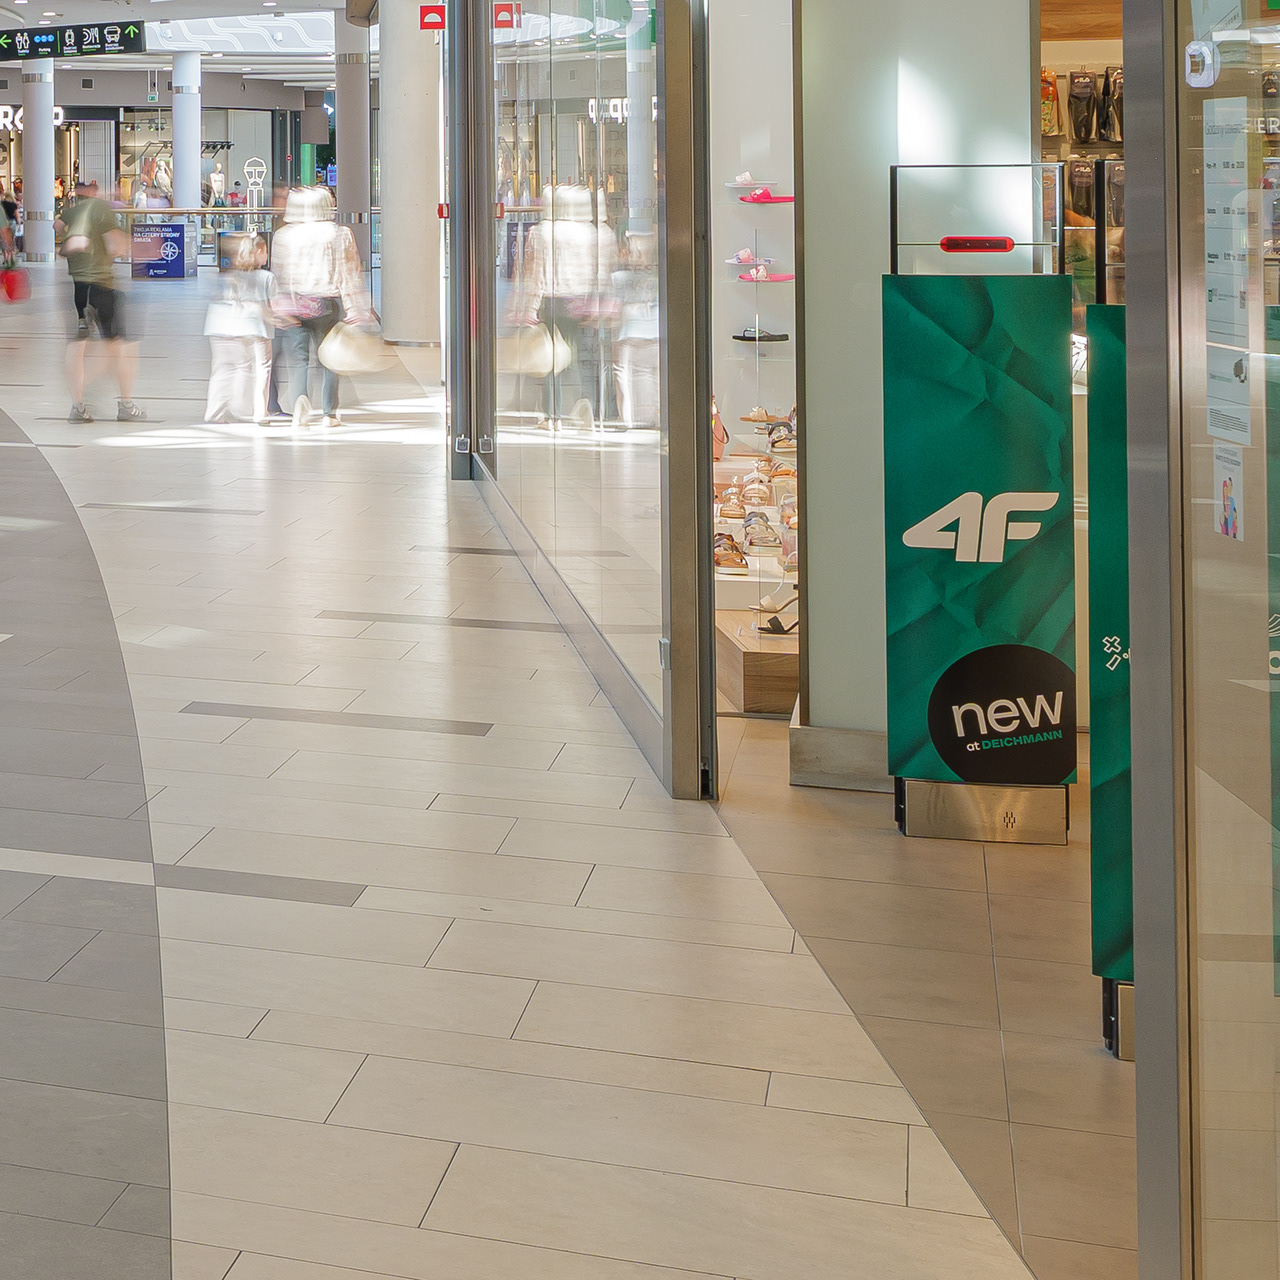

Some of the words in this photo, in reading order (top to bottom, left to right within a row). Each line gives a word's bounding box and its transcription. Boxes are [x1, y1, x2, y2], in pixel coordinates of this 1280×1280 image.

[902, 490, 1060, 563] 4F
[952, 690, 1064, 738] new
[966, 741, 981, 752] at
[981, 729, 1063, 750] DEICHMANN
